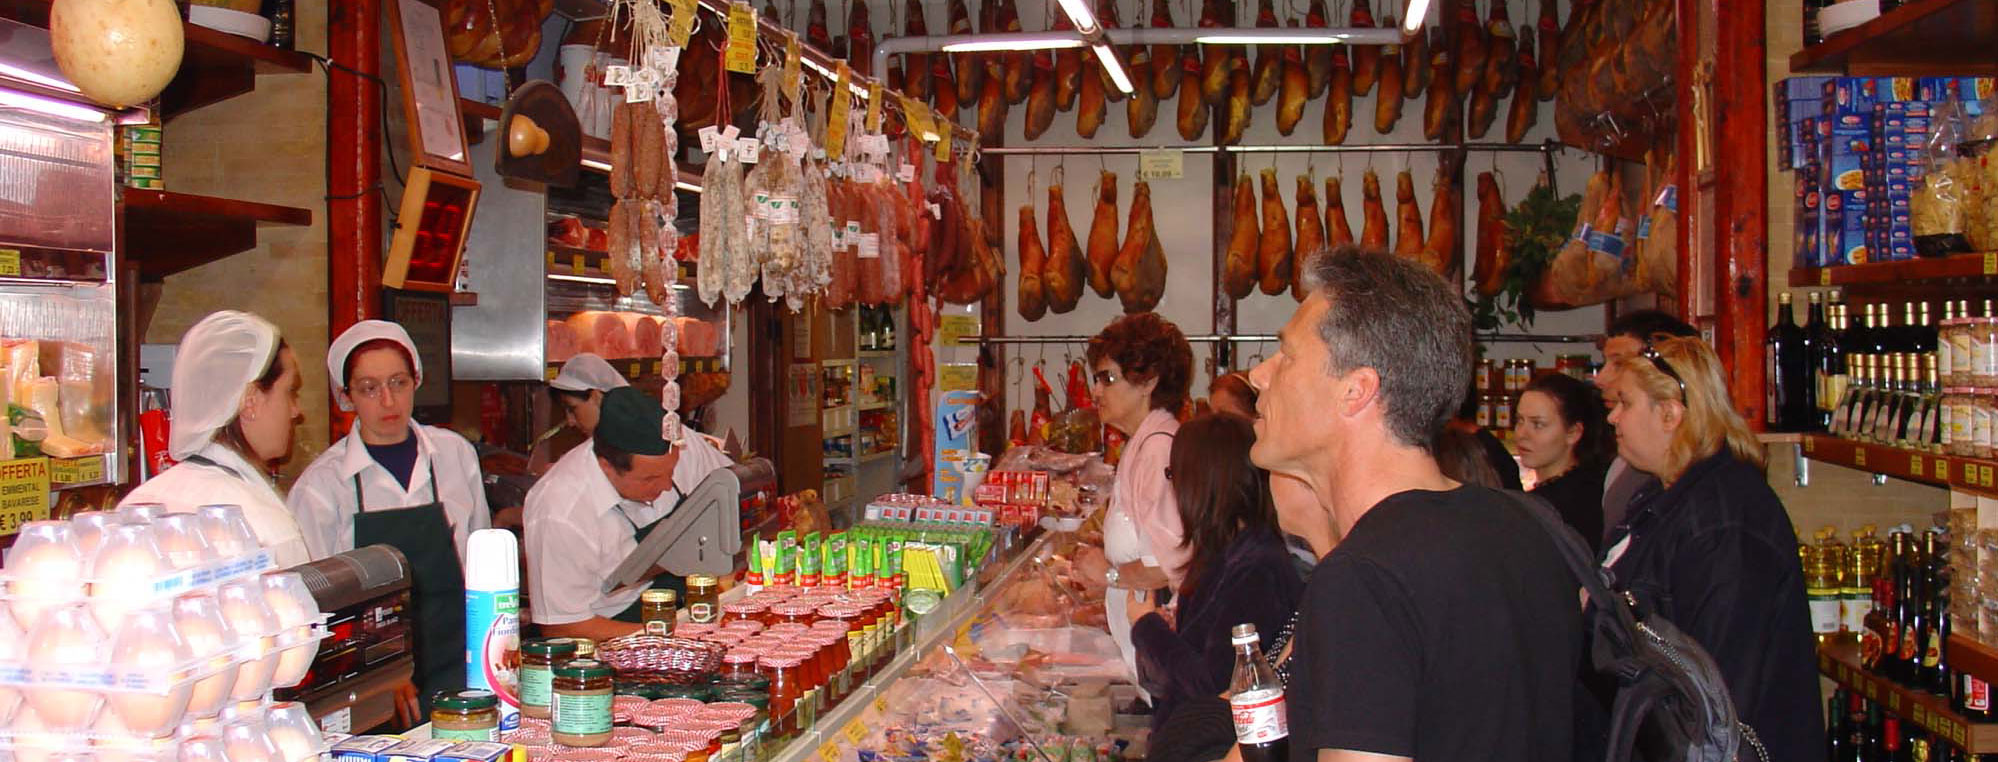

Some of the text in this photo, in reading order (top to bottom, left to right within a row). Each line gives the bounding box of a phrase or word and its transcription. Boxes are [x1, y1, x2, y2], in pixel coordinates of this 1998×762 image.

[0, 462, 47, 480] FFERTA
[2, 482, 40, 496] EMMENTAL
[2, 496, 40, 509] BAVARESE
